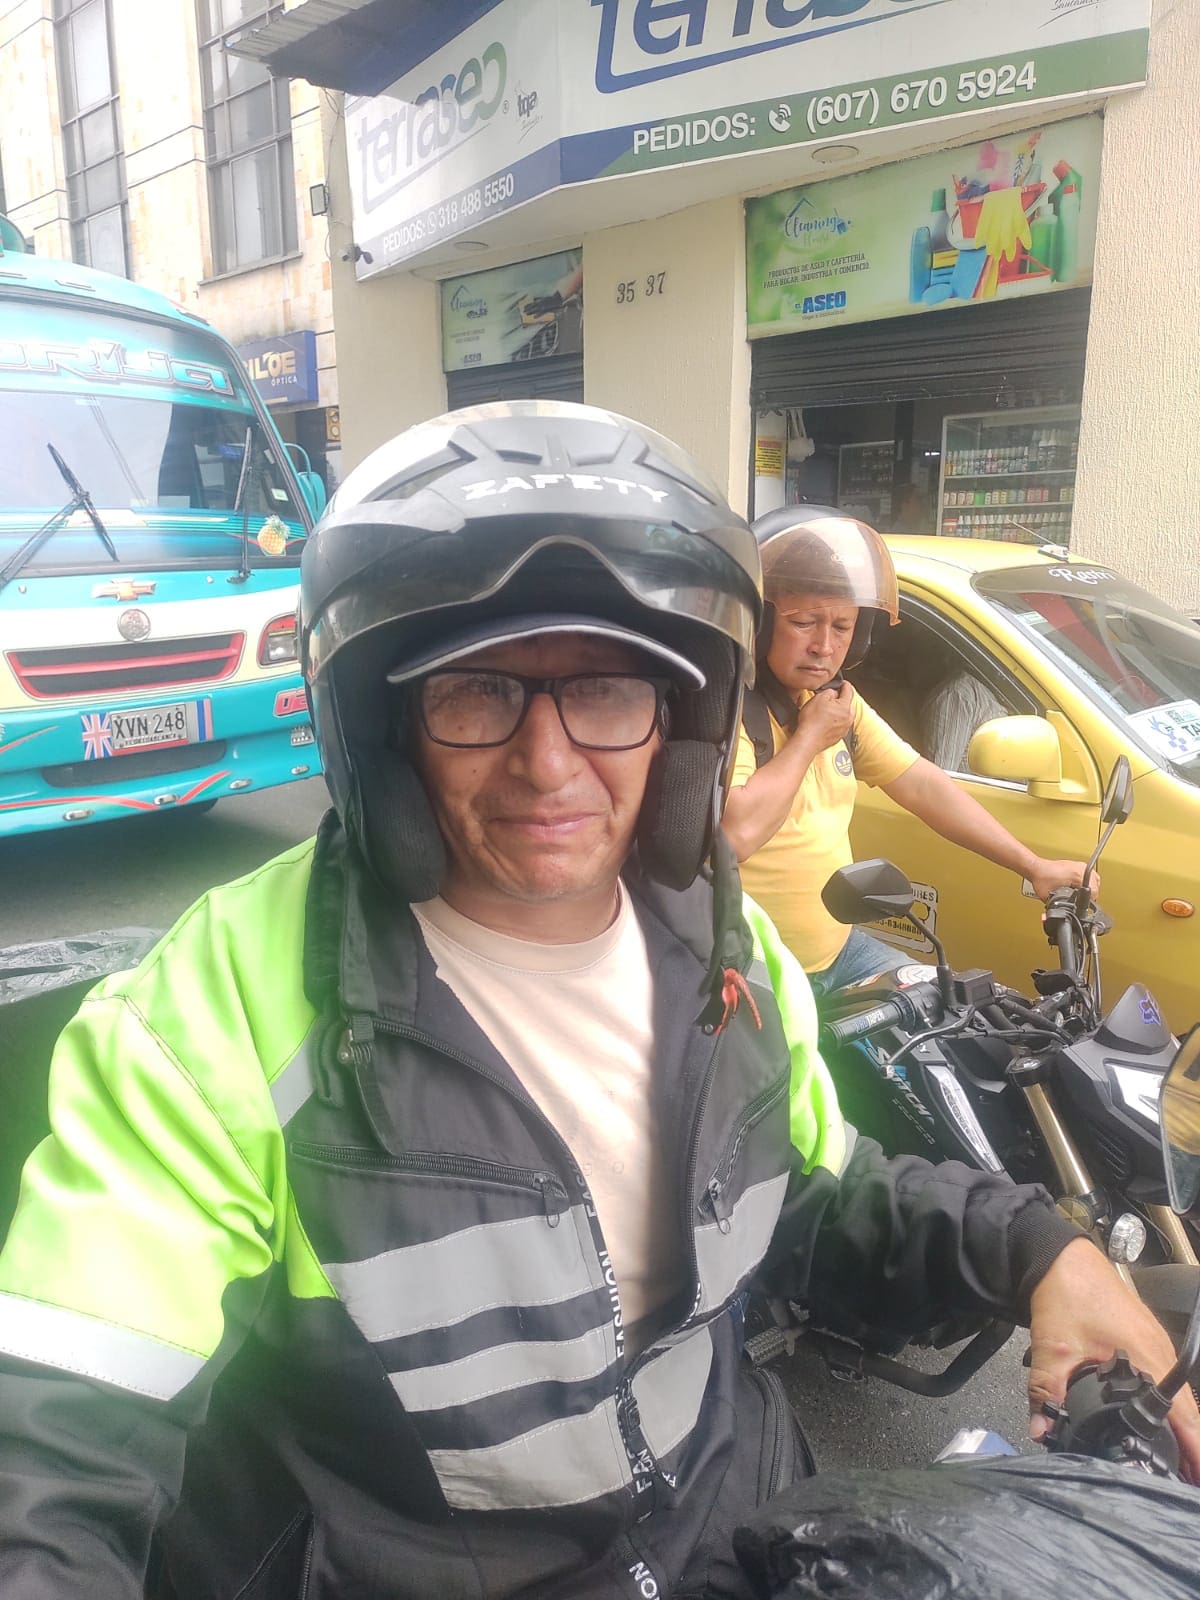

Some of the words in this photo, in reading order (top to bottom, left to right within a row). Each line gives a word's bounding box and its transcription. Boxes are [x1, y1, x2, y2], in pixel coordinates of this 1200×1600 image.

[633, 112, 756, 155] PEDIDOS:
[806, 87, 880, 134] (607)
[890, 76, 948, 114] 670
[956, 60, 1038, 103] 5924
[383, 220, 426, 255] PEDIDOS:
[438, 201, 458, 228] 318
[460, 189, 482, 217] 488
[484, 172, 514, 207] 5550
[616, 280, 637, 304] 35
[645, 270, 666, 297] 37
[803, 290, 847, 313] ASEO
[114, 716, 149, 739] XVN
[153, 711, 185, 734] 248
[598, 1249, 626, 1358] FASHION
